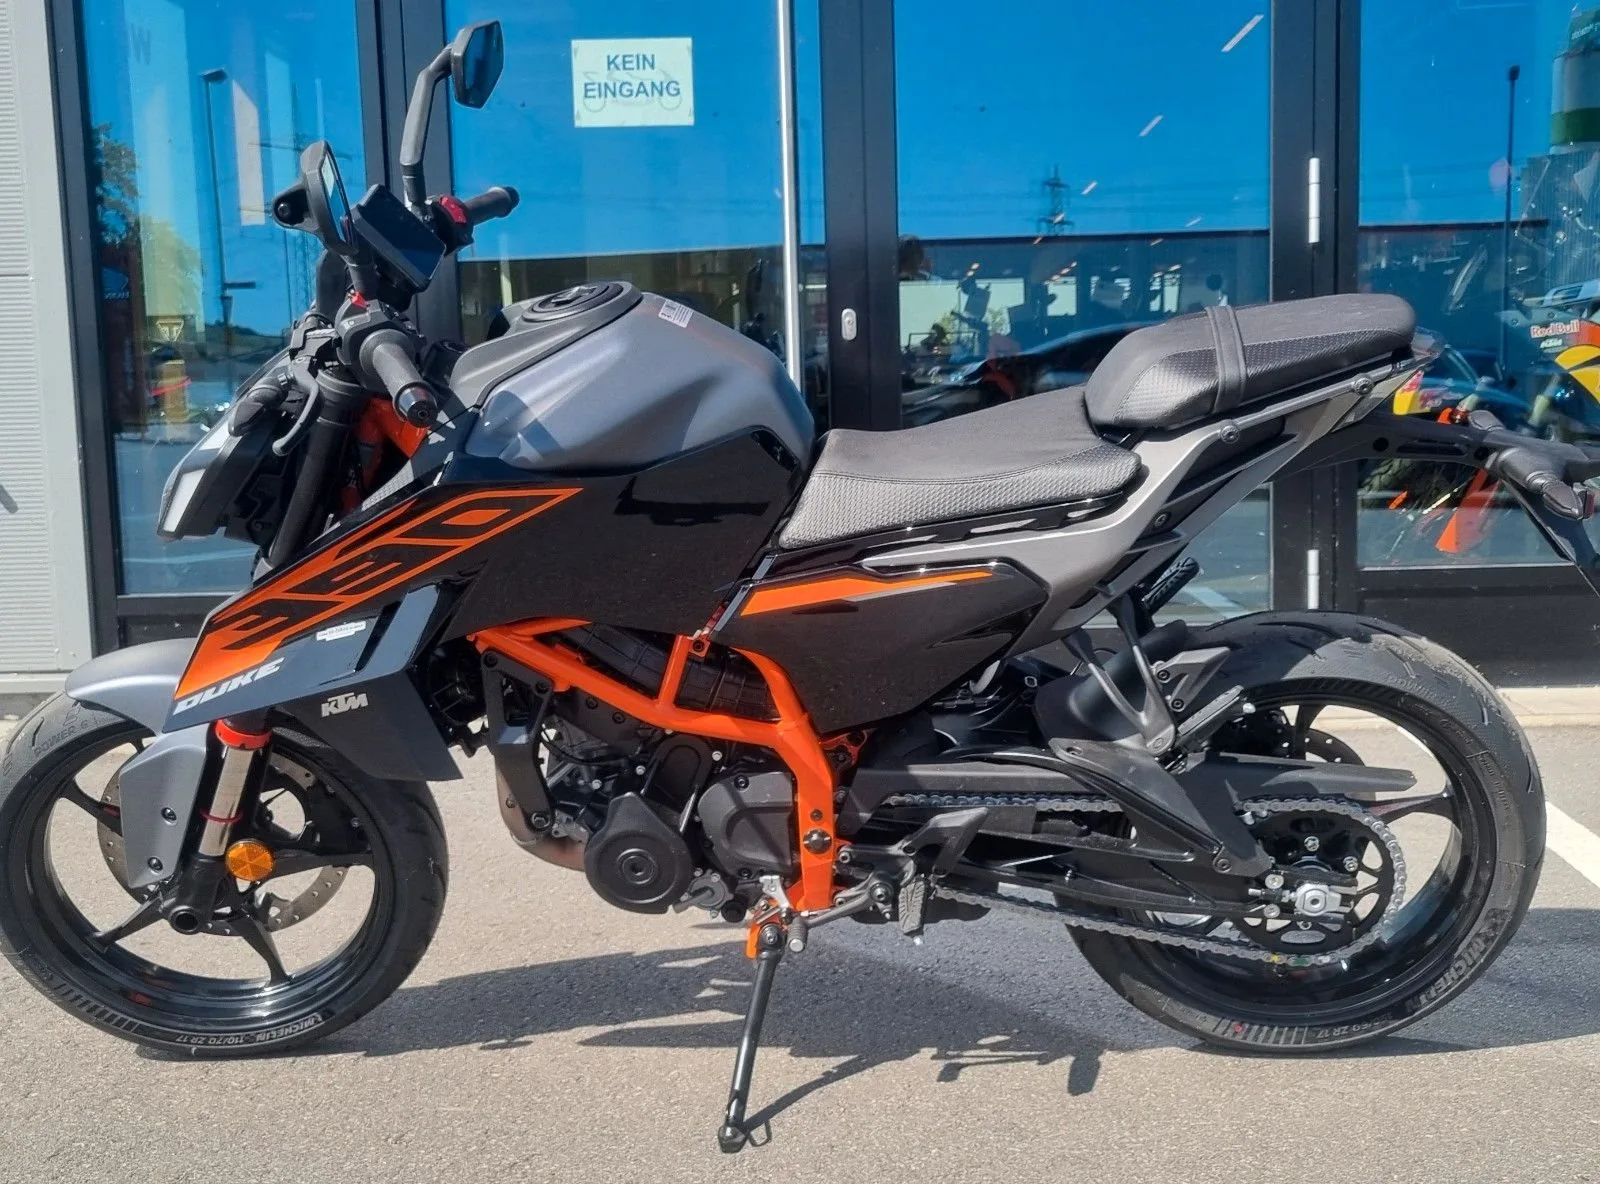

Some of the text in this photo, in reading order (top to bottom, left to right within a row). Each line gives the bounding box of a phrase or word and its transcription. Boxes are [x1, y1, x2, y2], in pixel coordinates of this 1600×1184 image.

[606, 53, 656, 72] KEIN
[583, 80, 681, 99] EINGANG
[1530, 319, 1580, 338] Red Bull
[172, 656, 286, 716] DUKE
[321, 692, 369, 718] KTM
[1404, 935, 1487, 1013] MICHELIN
[175, 1016, 316, 1045] MICHELIN 110/70 ZR 17
